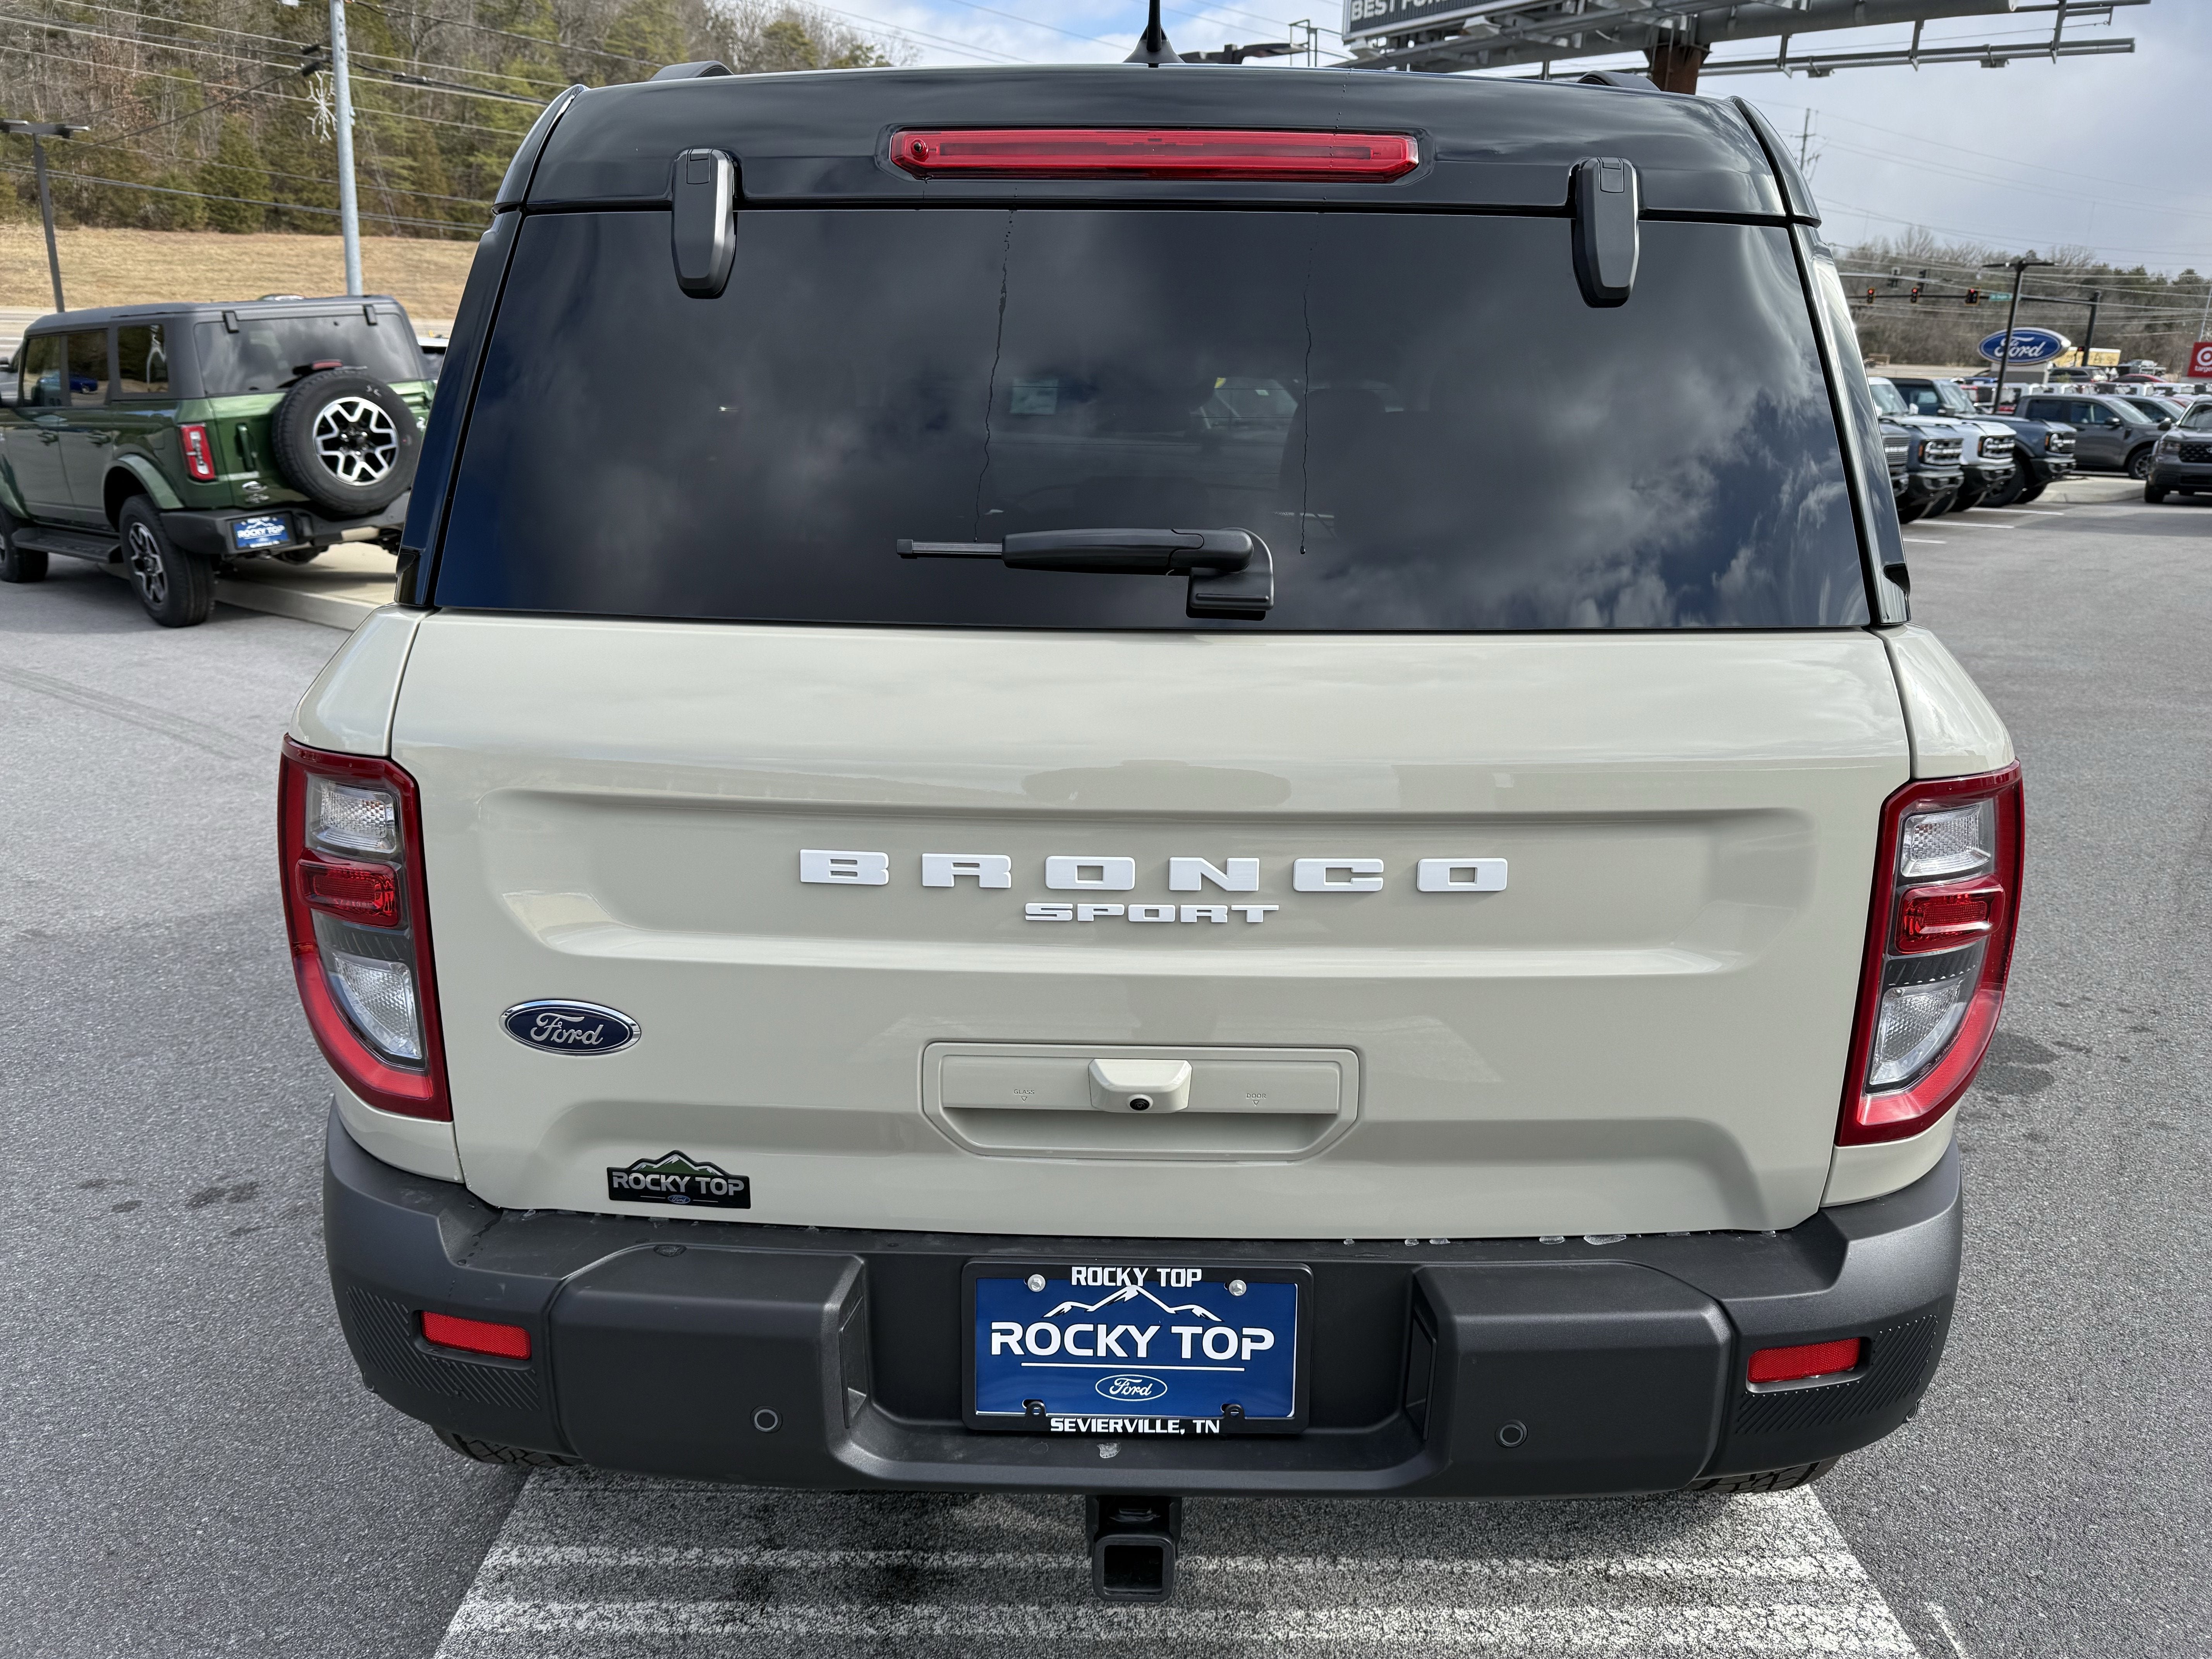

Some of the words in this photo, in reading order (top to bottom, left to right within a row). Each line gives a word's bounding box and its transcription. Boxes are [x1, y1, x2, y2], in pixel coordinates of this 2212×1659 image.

[1994, 336, 2046, 357] Ford
[800, 849, 1508, 892] BRONCO
[1025, 902, 1279, 924] SPORT
[530, 1012, 604, 1045] Ford
[612, 1171, 691, 1193] ROCKY
[695, 1177, 745, 1196] TOP
[1071, 1266, 1149, 1286] ROCKY
[1157, 1268, 1202, 1288] TOP
[991, 1321, 1160, 1358] ROCKY
[1171, 1326, 1275, 1360] TOP
[1109, 1377, 1153, 1396] Ford
[1050, 1418, 1185, 1435] SEVIERVILLE,
[1193, 1420, 1220, 1433] TN
